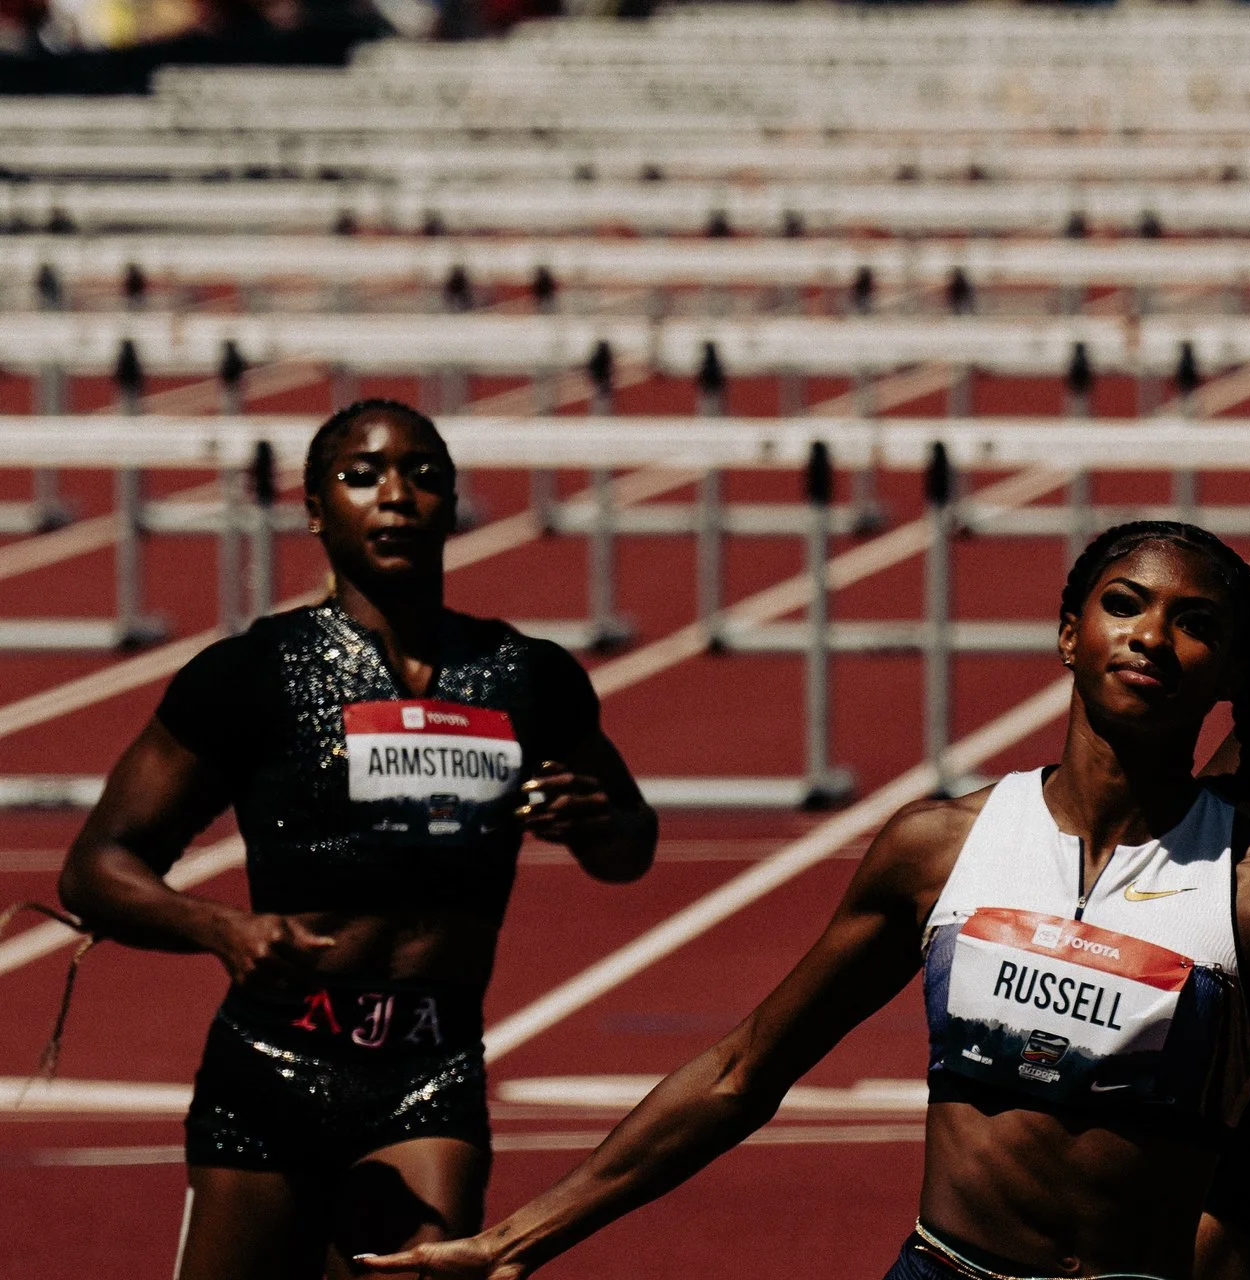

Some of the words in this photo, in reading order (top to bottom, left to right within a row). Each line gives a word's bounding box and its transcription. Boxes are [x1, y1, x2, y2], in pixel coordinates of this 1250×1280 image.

[368, 747, 510, 782] ARMSTRONG
[1063, 935, 1121, 960] TOYOTA
[289, 986, 444, 1049] AJA
[993, 960, 1122, 1031] RUSSELL
